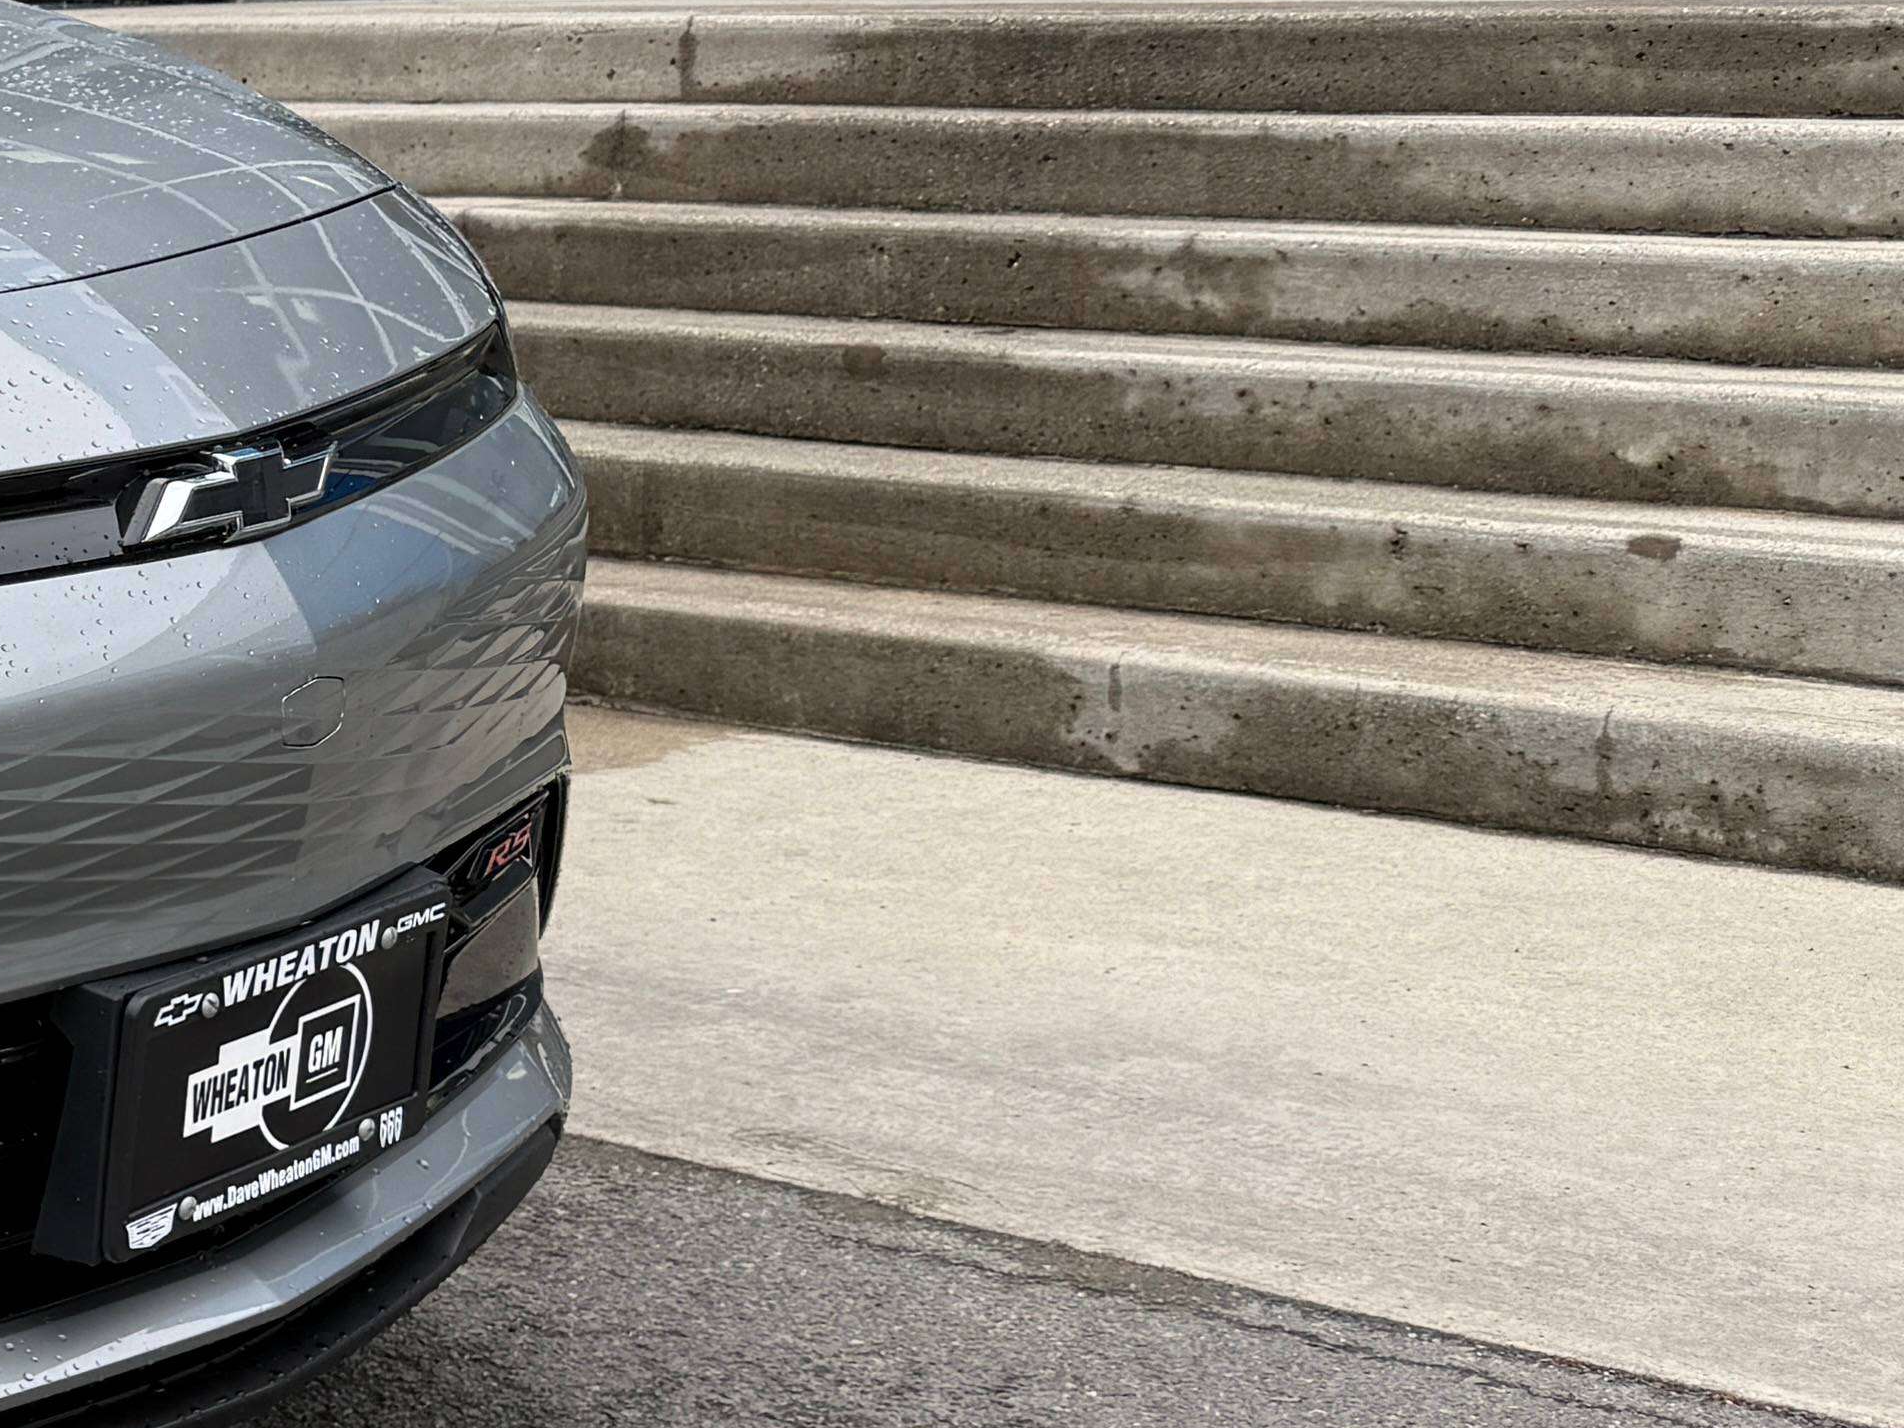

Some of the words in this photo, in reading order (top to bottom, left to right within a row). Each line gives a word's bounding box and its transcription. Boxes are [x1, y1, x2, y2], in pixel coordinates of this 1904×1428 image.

[482, 821, 533, 878] RS
[222, 920, 382, 1008] WHEATON
[396, 902, 447, 933] GMC
[192, 1046, 293, 1125] WHEATON
[307, 1025, 345, 1070] GM
[193, 1134, 360, 1222] www.DaveWheatonGM.com
